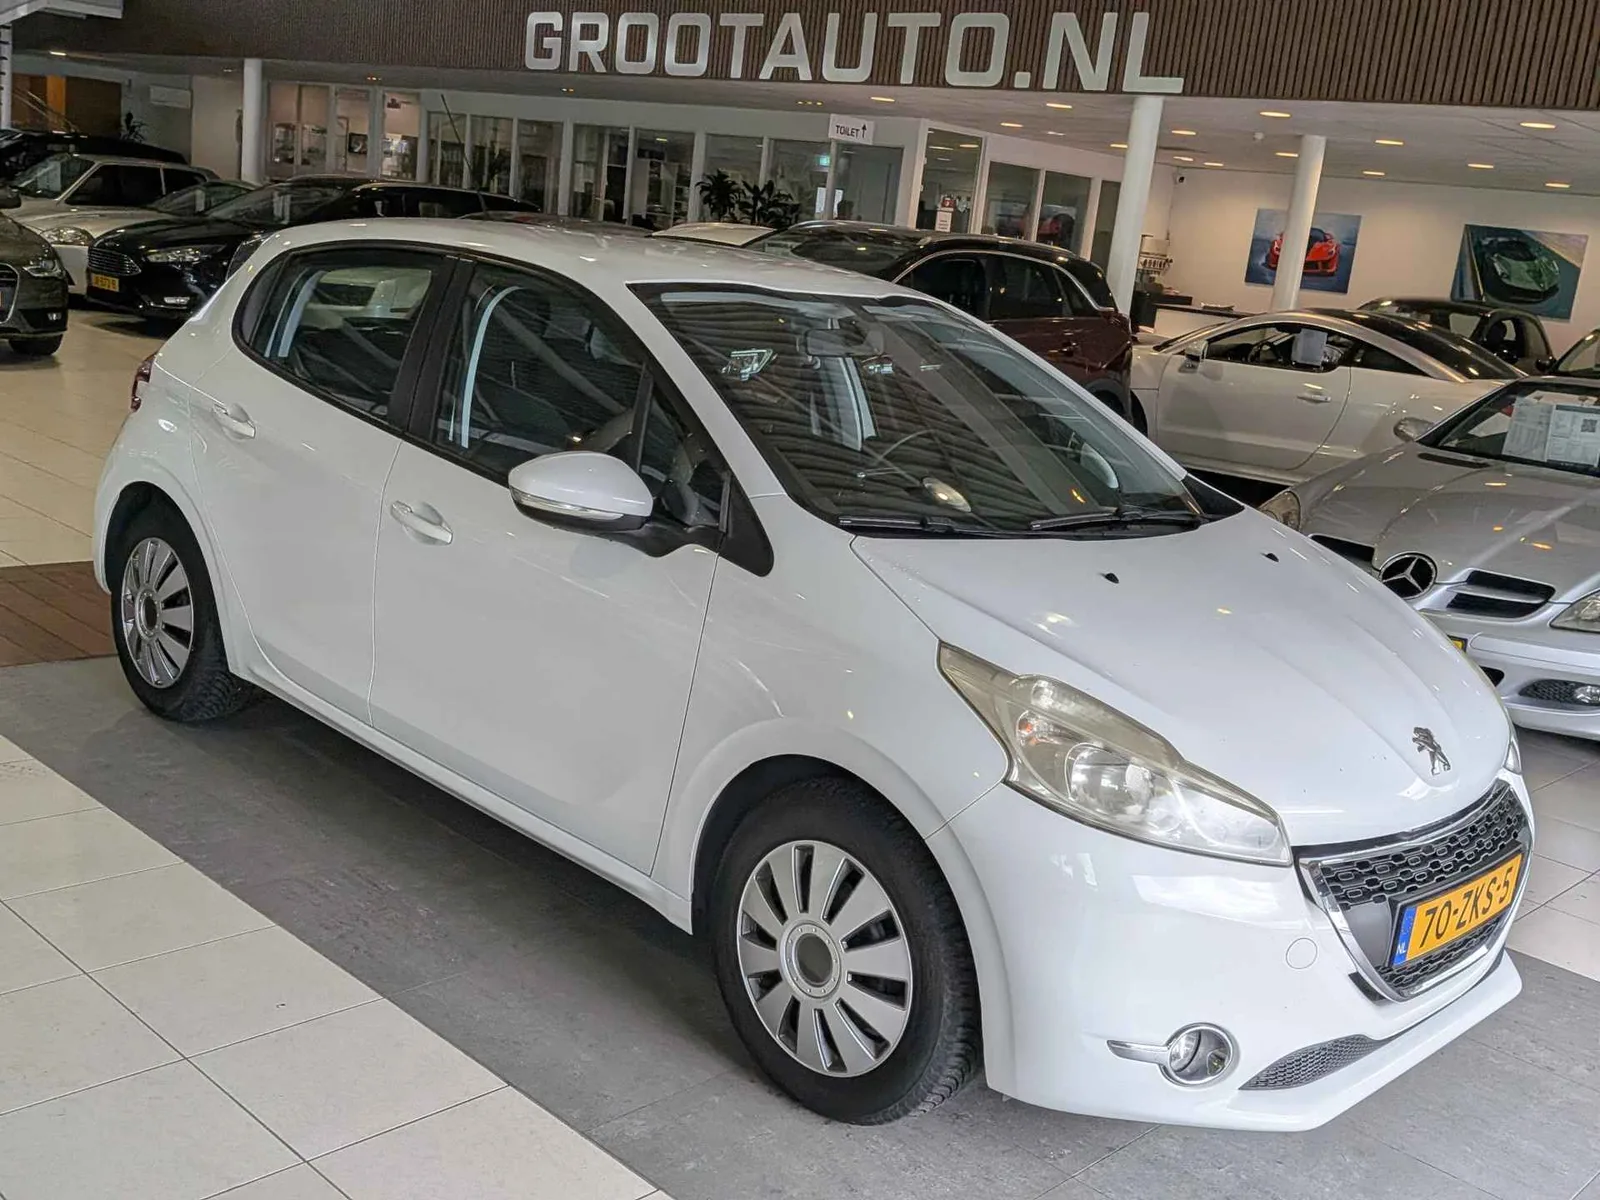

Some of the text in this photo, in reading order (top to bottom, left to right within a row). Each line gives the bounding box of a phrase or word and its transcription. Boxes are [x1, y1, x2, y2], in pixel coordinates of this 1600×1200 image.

[525, 11, 1184, 94] GROOTAUTO.NL
[835, 125, 860, 138] TOILET
[1419, 867, 1513, 948] 70-ZKS-5
